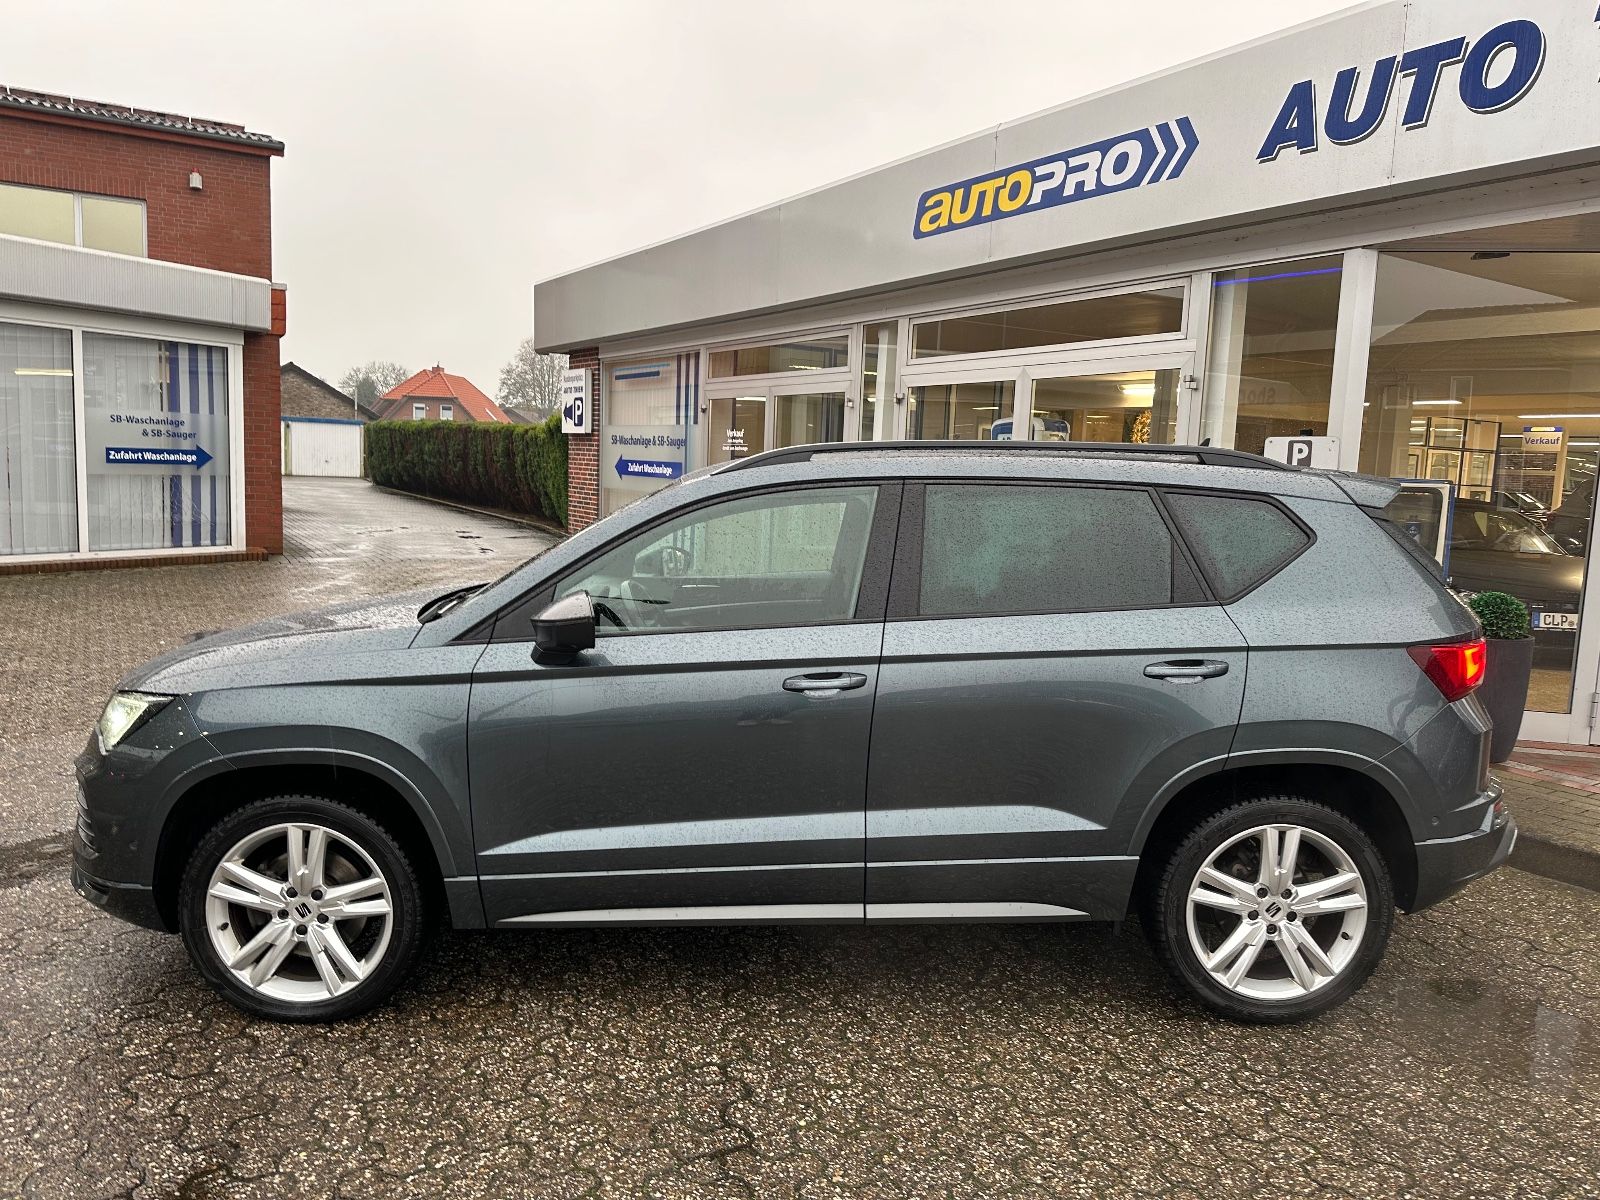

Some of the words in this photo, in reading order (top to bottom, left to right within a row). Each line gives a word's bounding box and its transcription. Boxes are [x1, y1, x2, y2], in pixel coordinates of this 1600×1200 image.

[1256, 19, 1546, 163] AUTO
[574, 399, 583, 424] P
[110, 414, 185, 428] SB-Waschanlage
[142, 428, 149, 437] &
[151, 429, 197, 440] SB-Sauger
[726, 428, 745, 438] Verkauf
[611, 434, 652, 449] SB-Waschanlage
[652, 436, 657, 447] &
[657, 436, 687, 450] SB-Sauger
[1524, 436, 1561, 445] Verkauf
[109, 450, 142, 460] Zufahrt
[143, 451, 197, 463] Waschanlage
[1292, 442, 1309, 465] P
[627, 462, 644, 473] Zufahrt
[644, 464, 673, 476] Waschanlage
[1543, 614, 1568, 627] CLP
